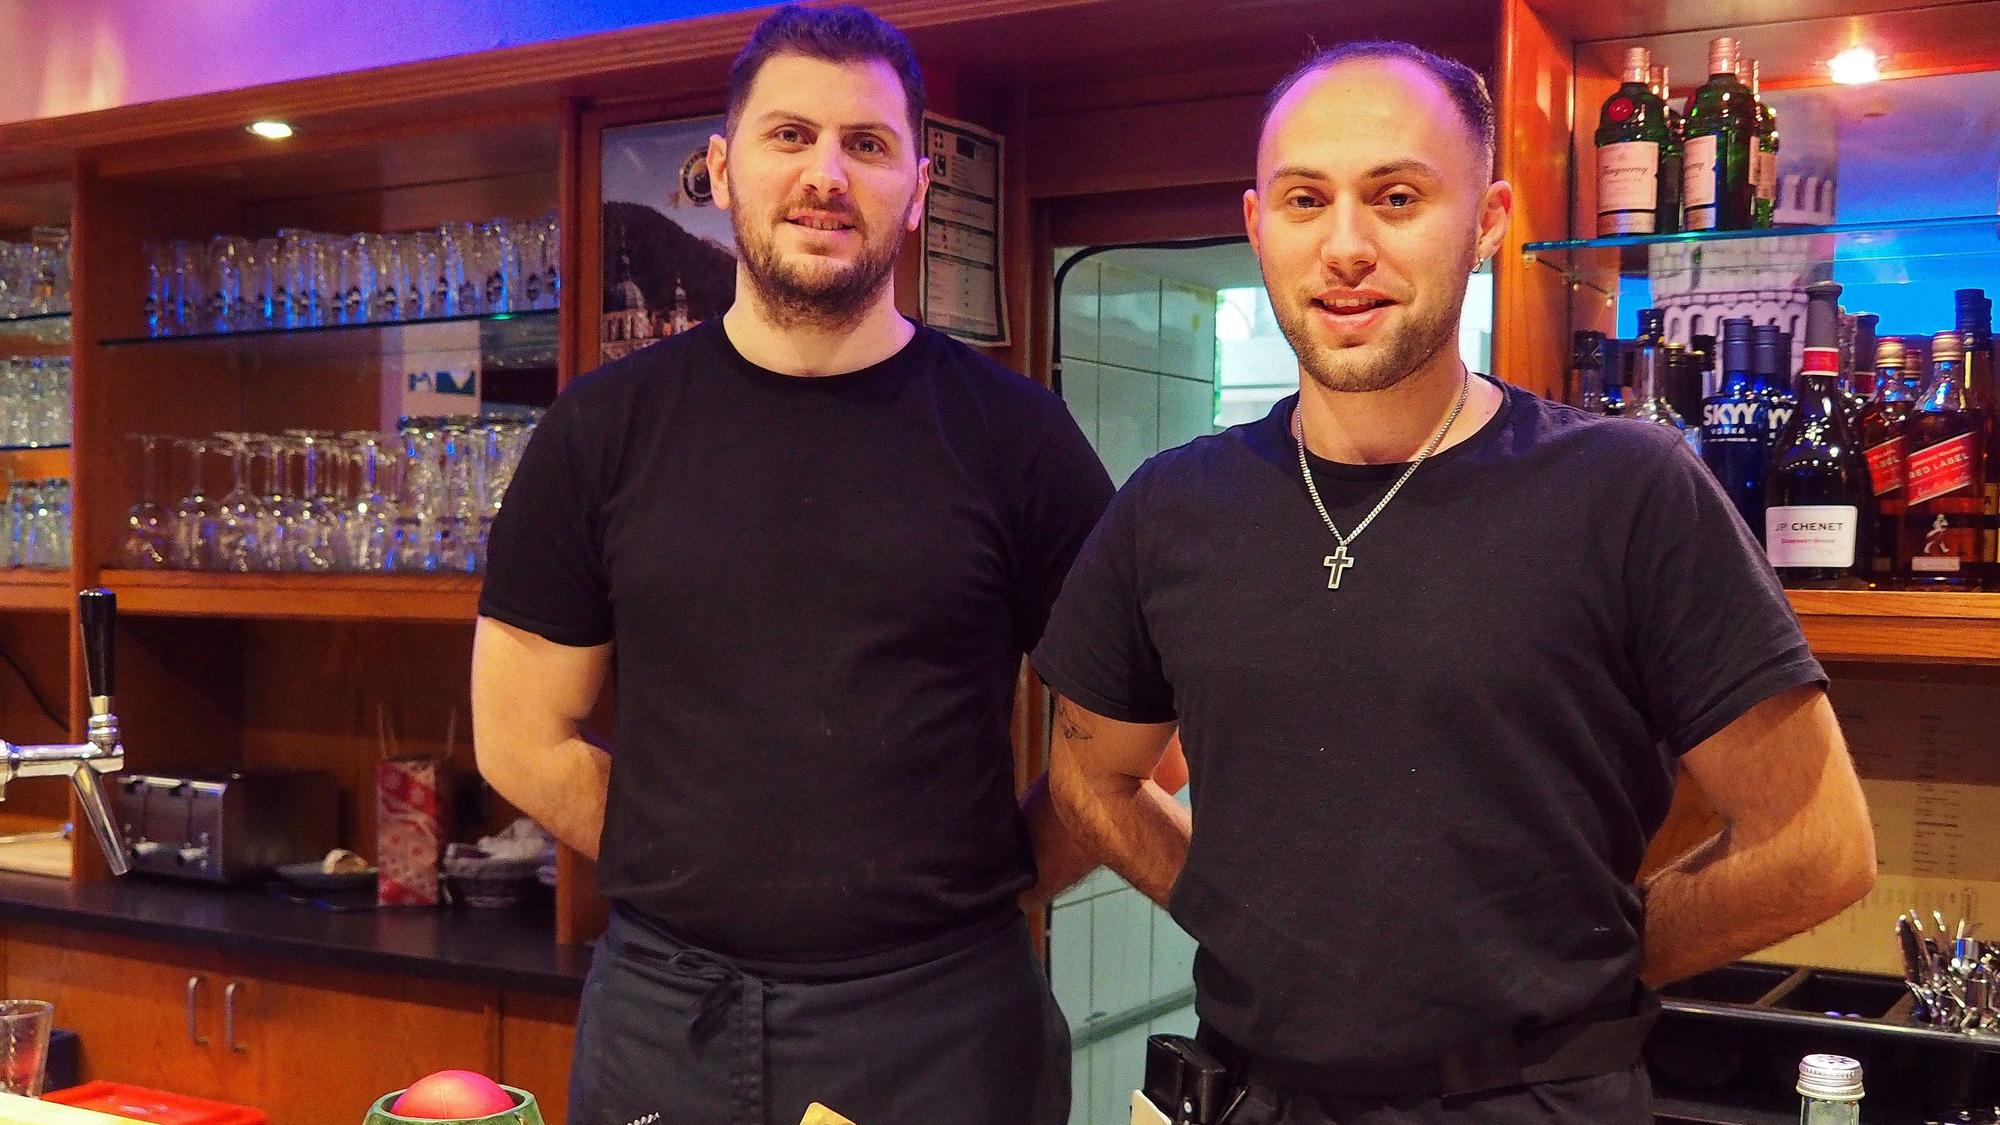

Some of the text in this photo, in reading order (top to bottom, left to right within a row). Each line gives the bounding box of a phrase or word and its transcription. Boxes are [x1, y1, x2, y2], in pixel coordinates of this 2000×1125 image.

[1703, 402, 1759, 426] SKYY
[1710, 427, 1746, 435] VODKA
[1908, 452, 1970, 480] RED LABEL
[1775, 522, 1844, 532] JP CHENET
